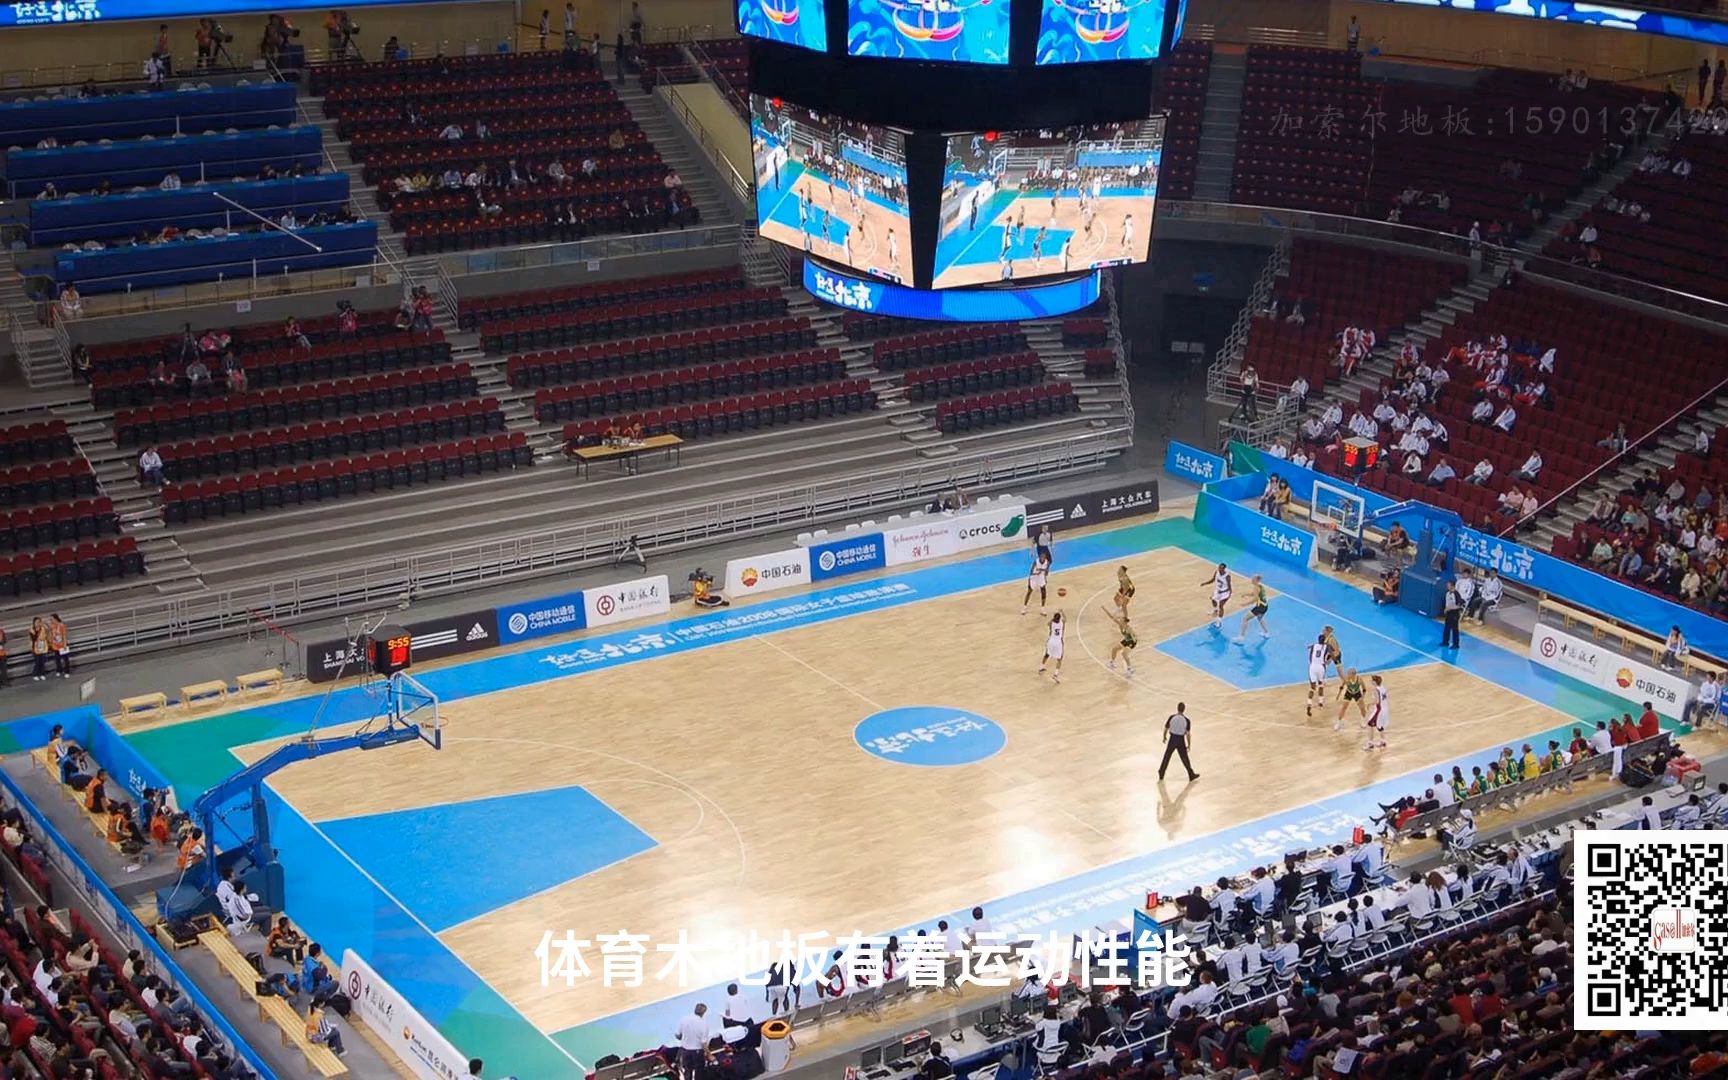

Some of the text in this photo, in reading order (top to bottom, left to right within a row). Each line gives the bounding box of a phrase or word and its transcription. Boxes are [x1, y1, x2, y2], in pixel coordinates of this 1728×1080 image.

[969, 523, 1001, 537] crocs
[761, 563, 802, 579] 中国石油
[388, 637, 410, 650] 9:55
[1636, 678, 1677, 704] 中国石油
